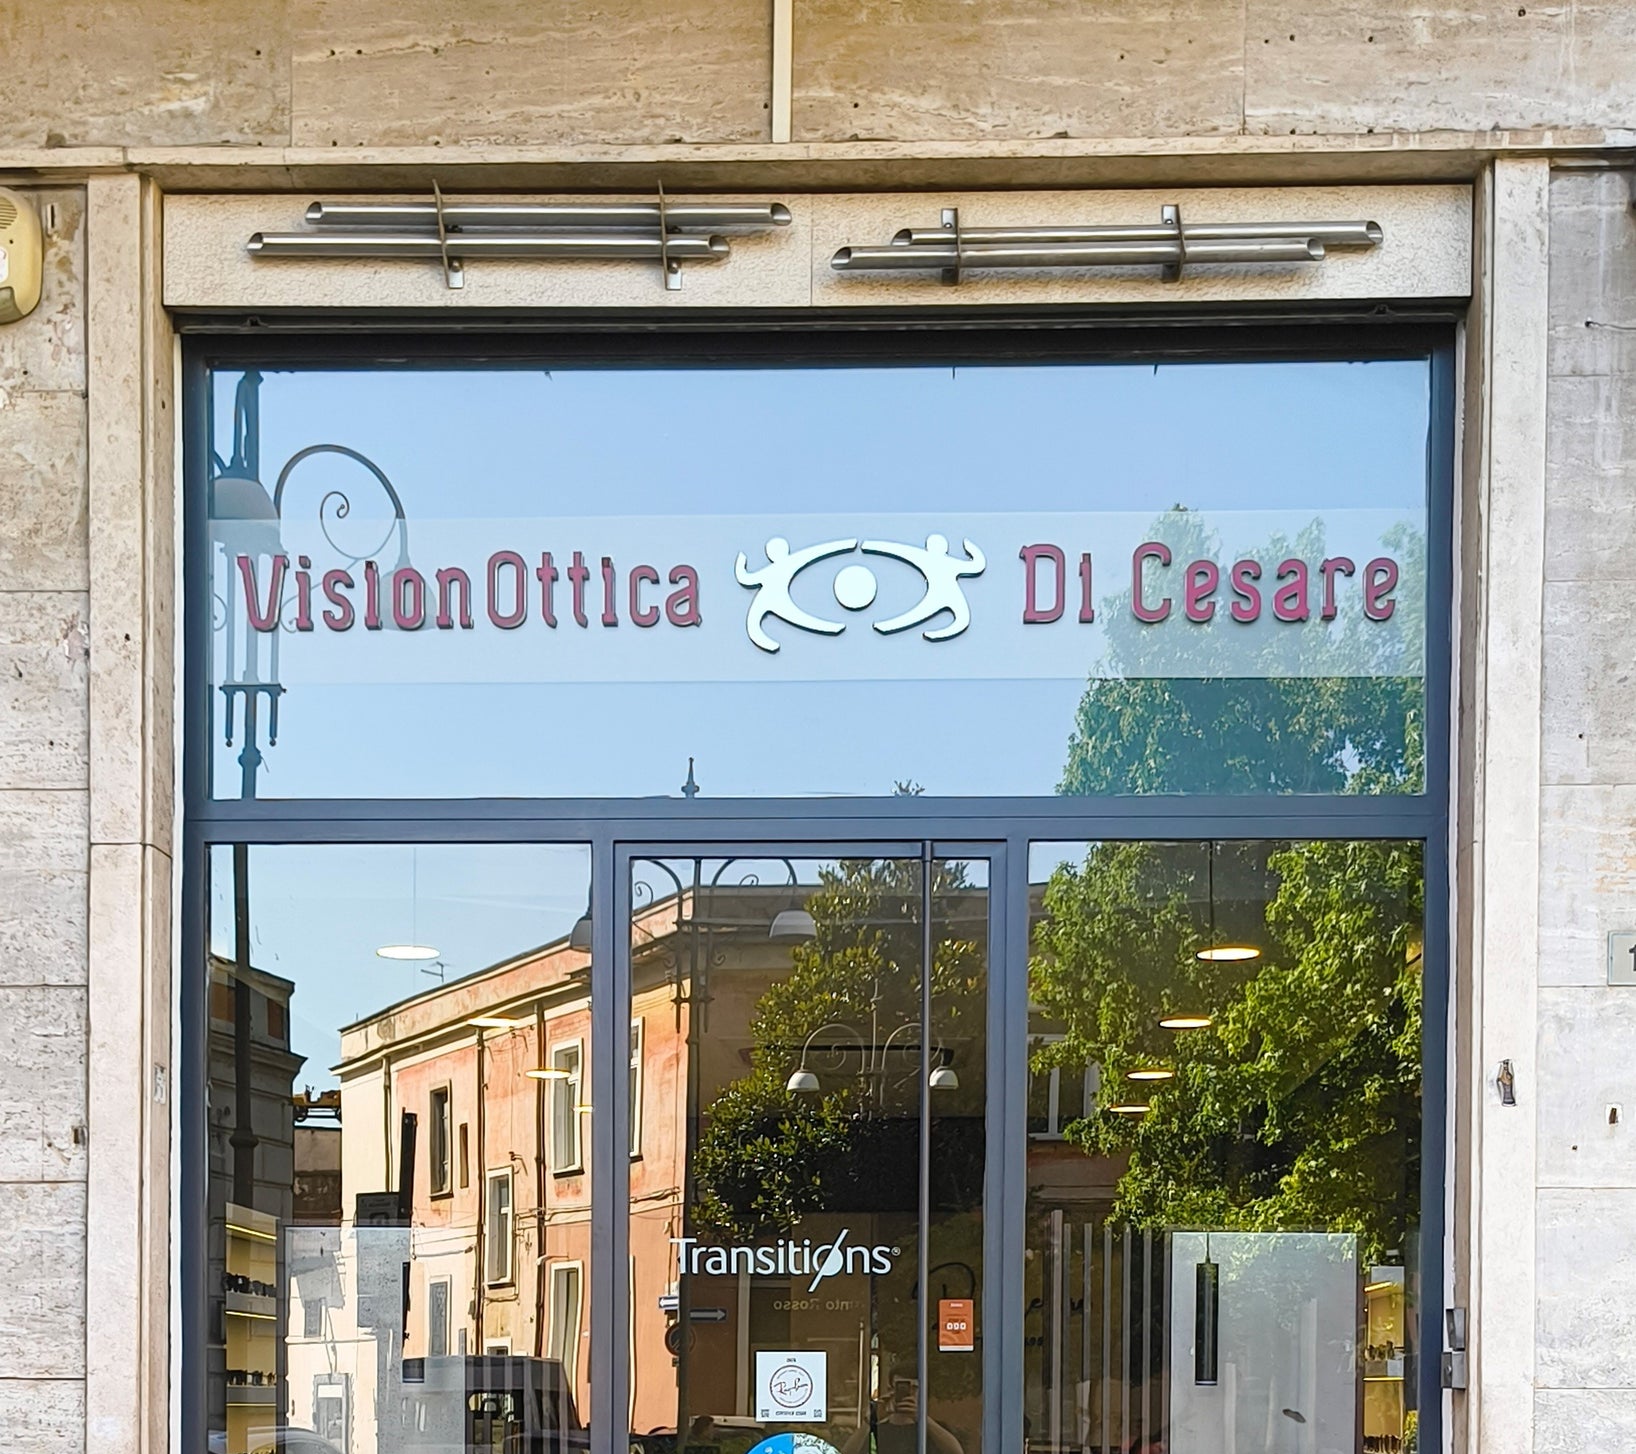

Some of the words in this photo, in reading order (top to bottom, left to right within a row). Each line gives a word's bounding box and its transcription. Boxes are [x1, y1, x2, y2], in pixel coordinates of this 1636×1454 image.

[236, 550, 702, 632] VisionOttica
[1019, 543, 1095, 624] Di
[1131, 541, 1399, 624] Cesare
